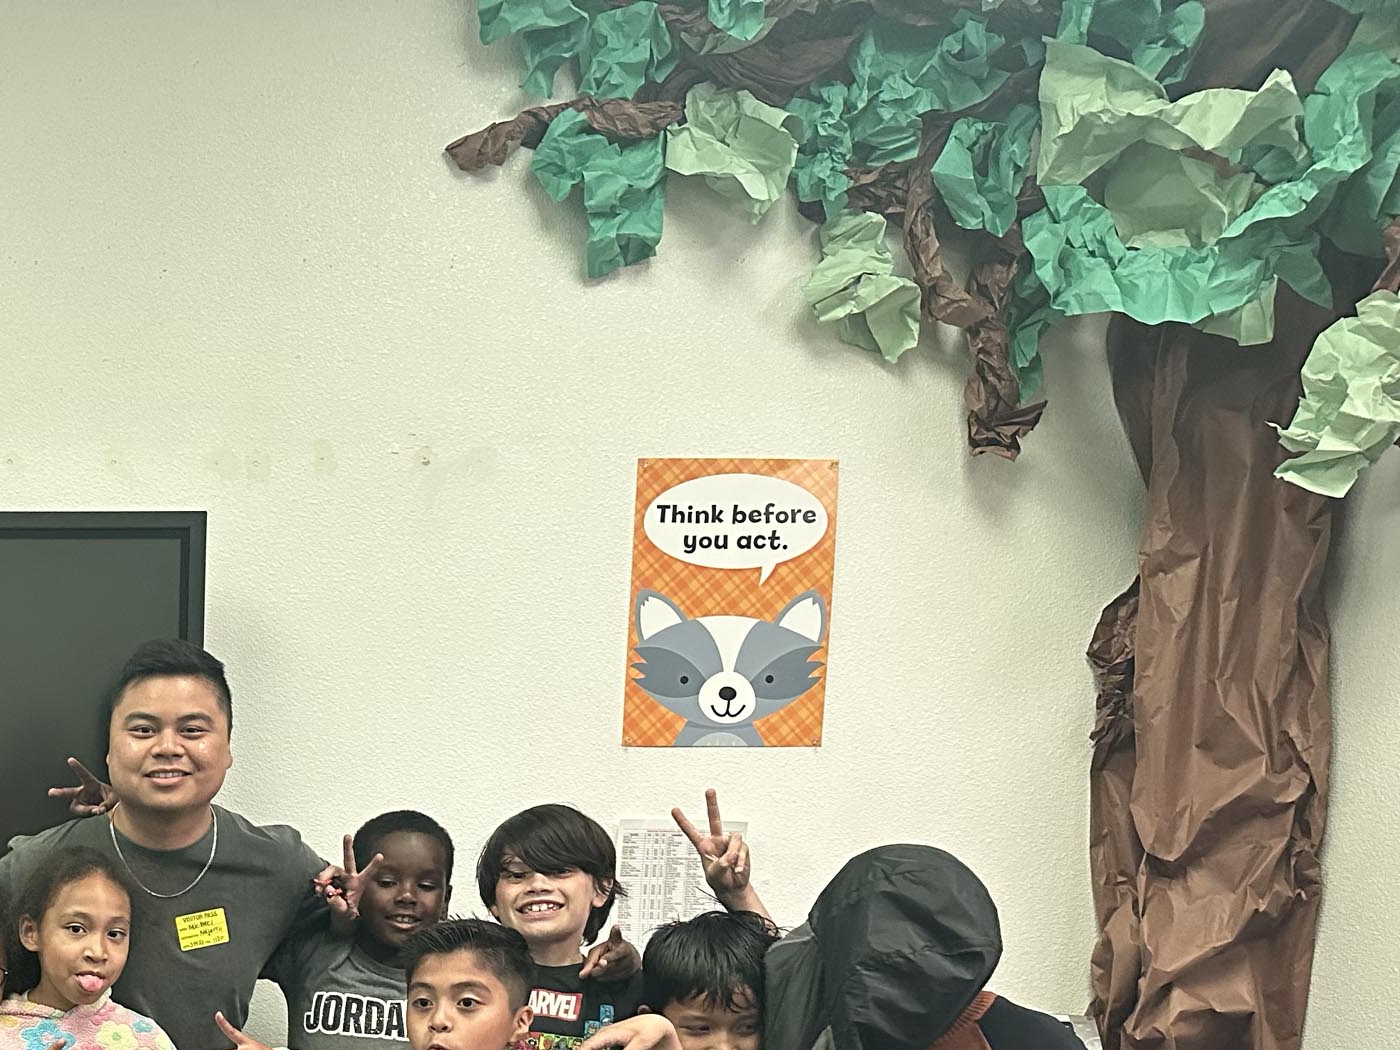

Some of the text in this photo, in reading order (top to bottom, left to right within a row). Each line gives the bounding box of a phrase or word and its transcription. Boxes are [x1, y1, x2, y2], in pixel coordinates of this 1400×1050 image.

[656, 503, 817, 524] Think before
[683, 530, 788, 554] you act.
[304, 991, 409, 1041] JORDA
[528, 989, 578, 1020] ARVEL
